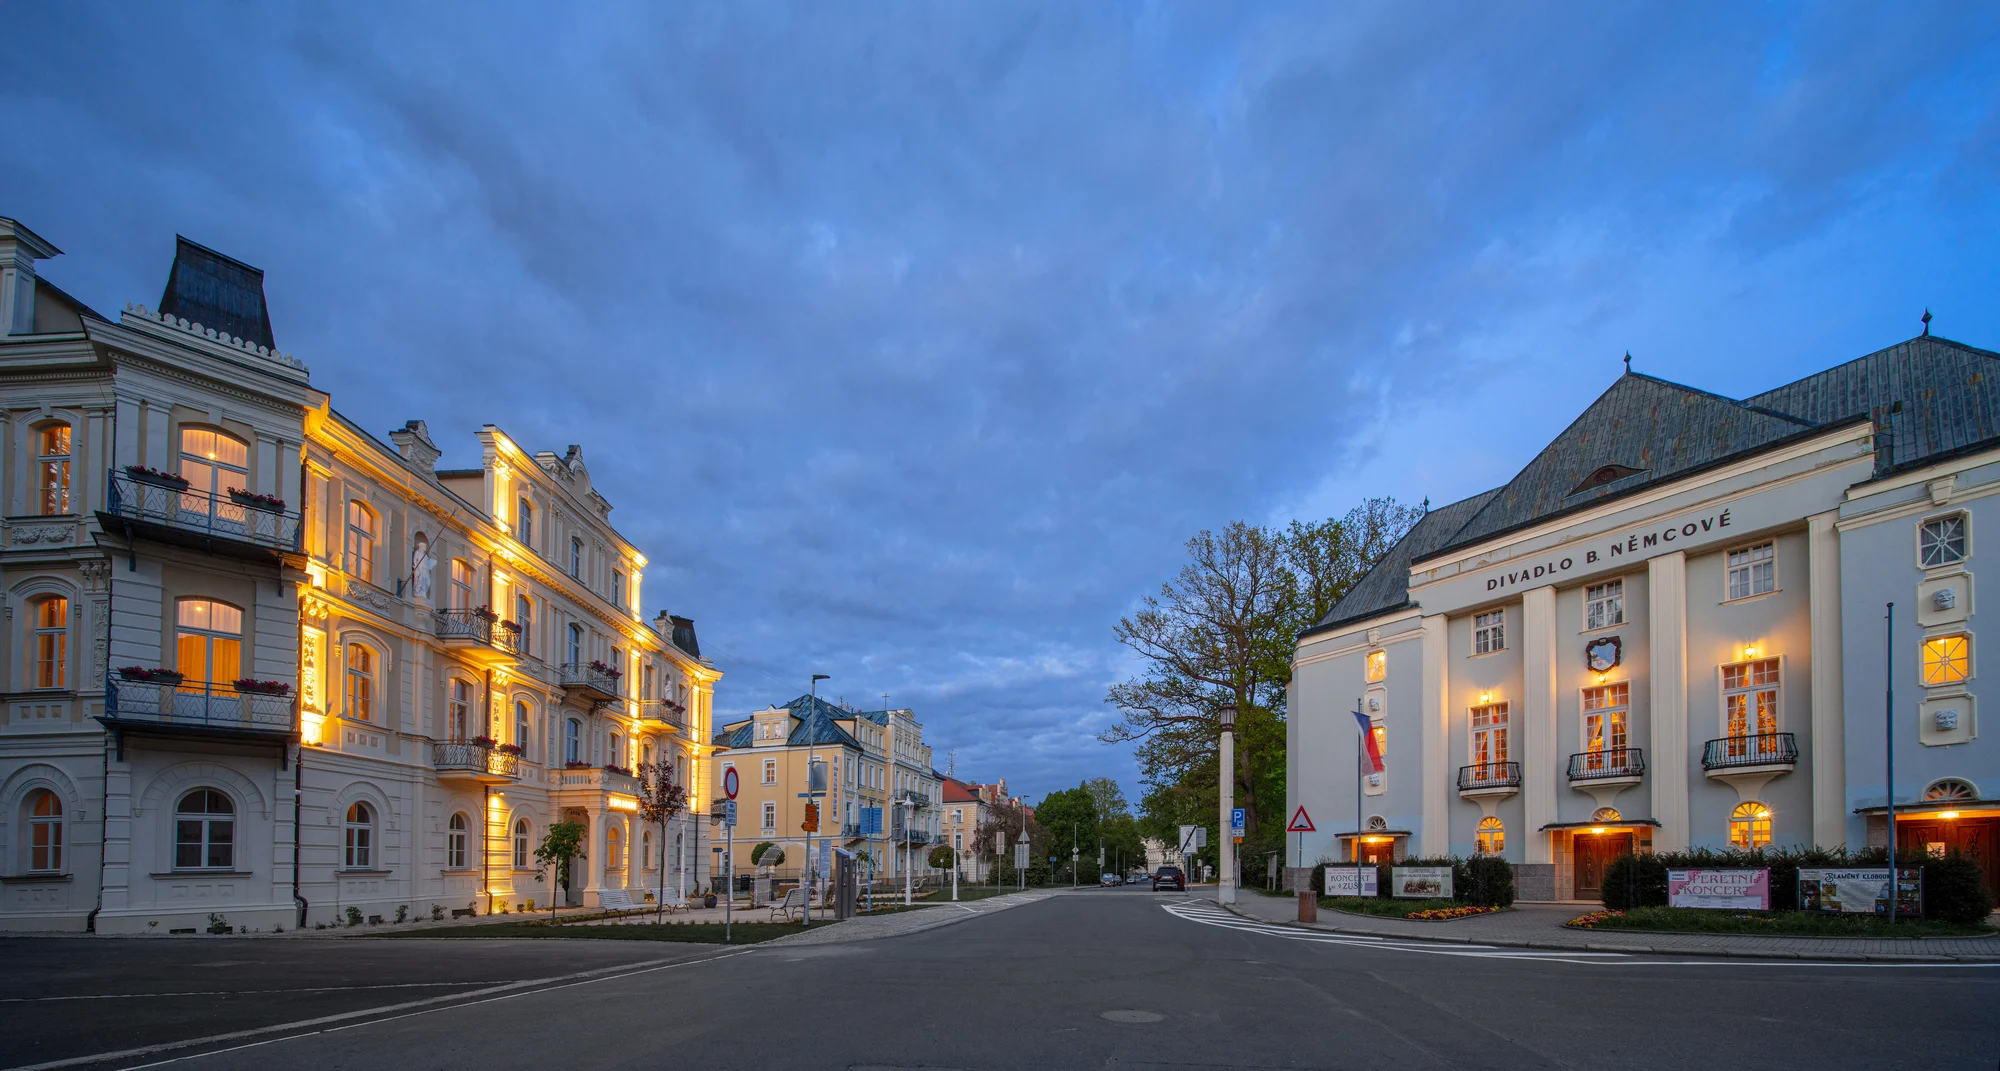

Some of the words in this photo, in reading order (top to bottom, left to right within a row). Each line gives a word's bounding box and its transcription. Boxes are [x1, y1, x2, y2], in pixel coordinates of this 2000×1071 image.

[1486, 557, 1573, 591] DIVADLO
[1586, 550, 1601, 564] B.
[1610, 508, 1732, 557] NĚMCOVÉ
[1234, 811, 1242, 823] P
